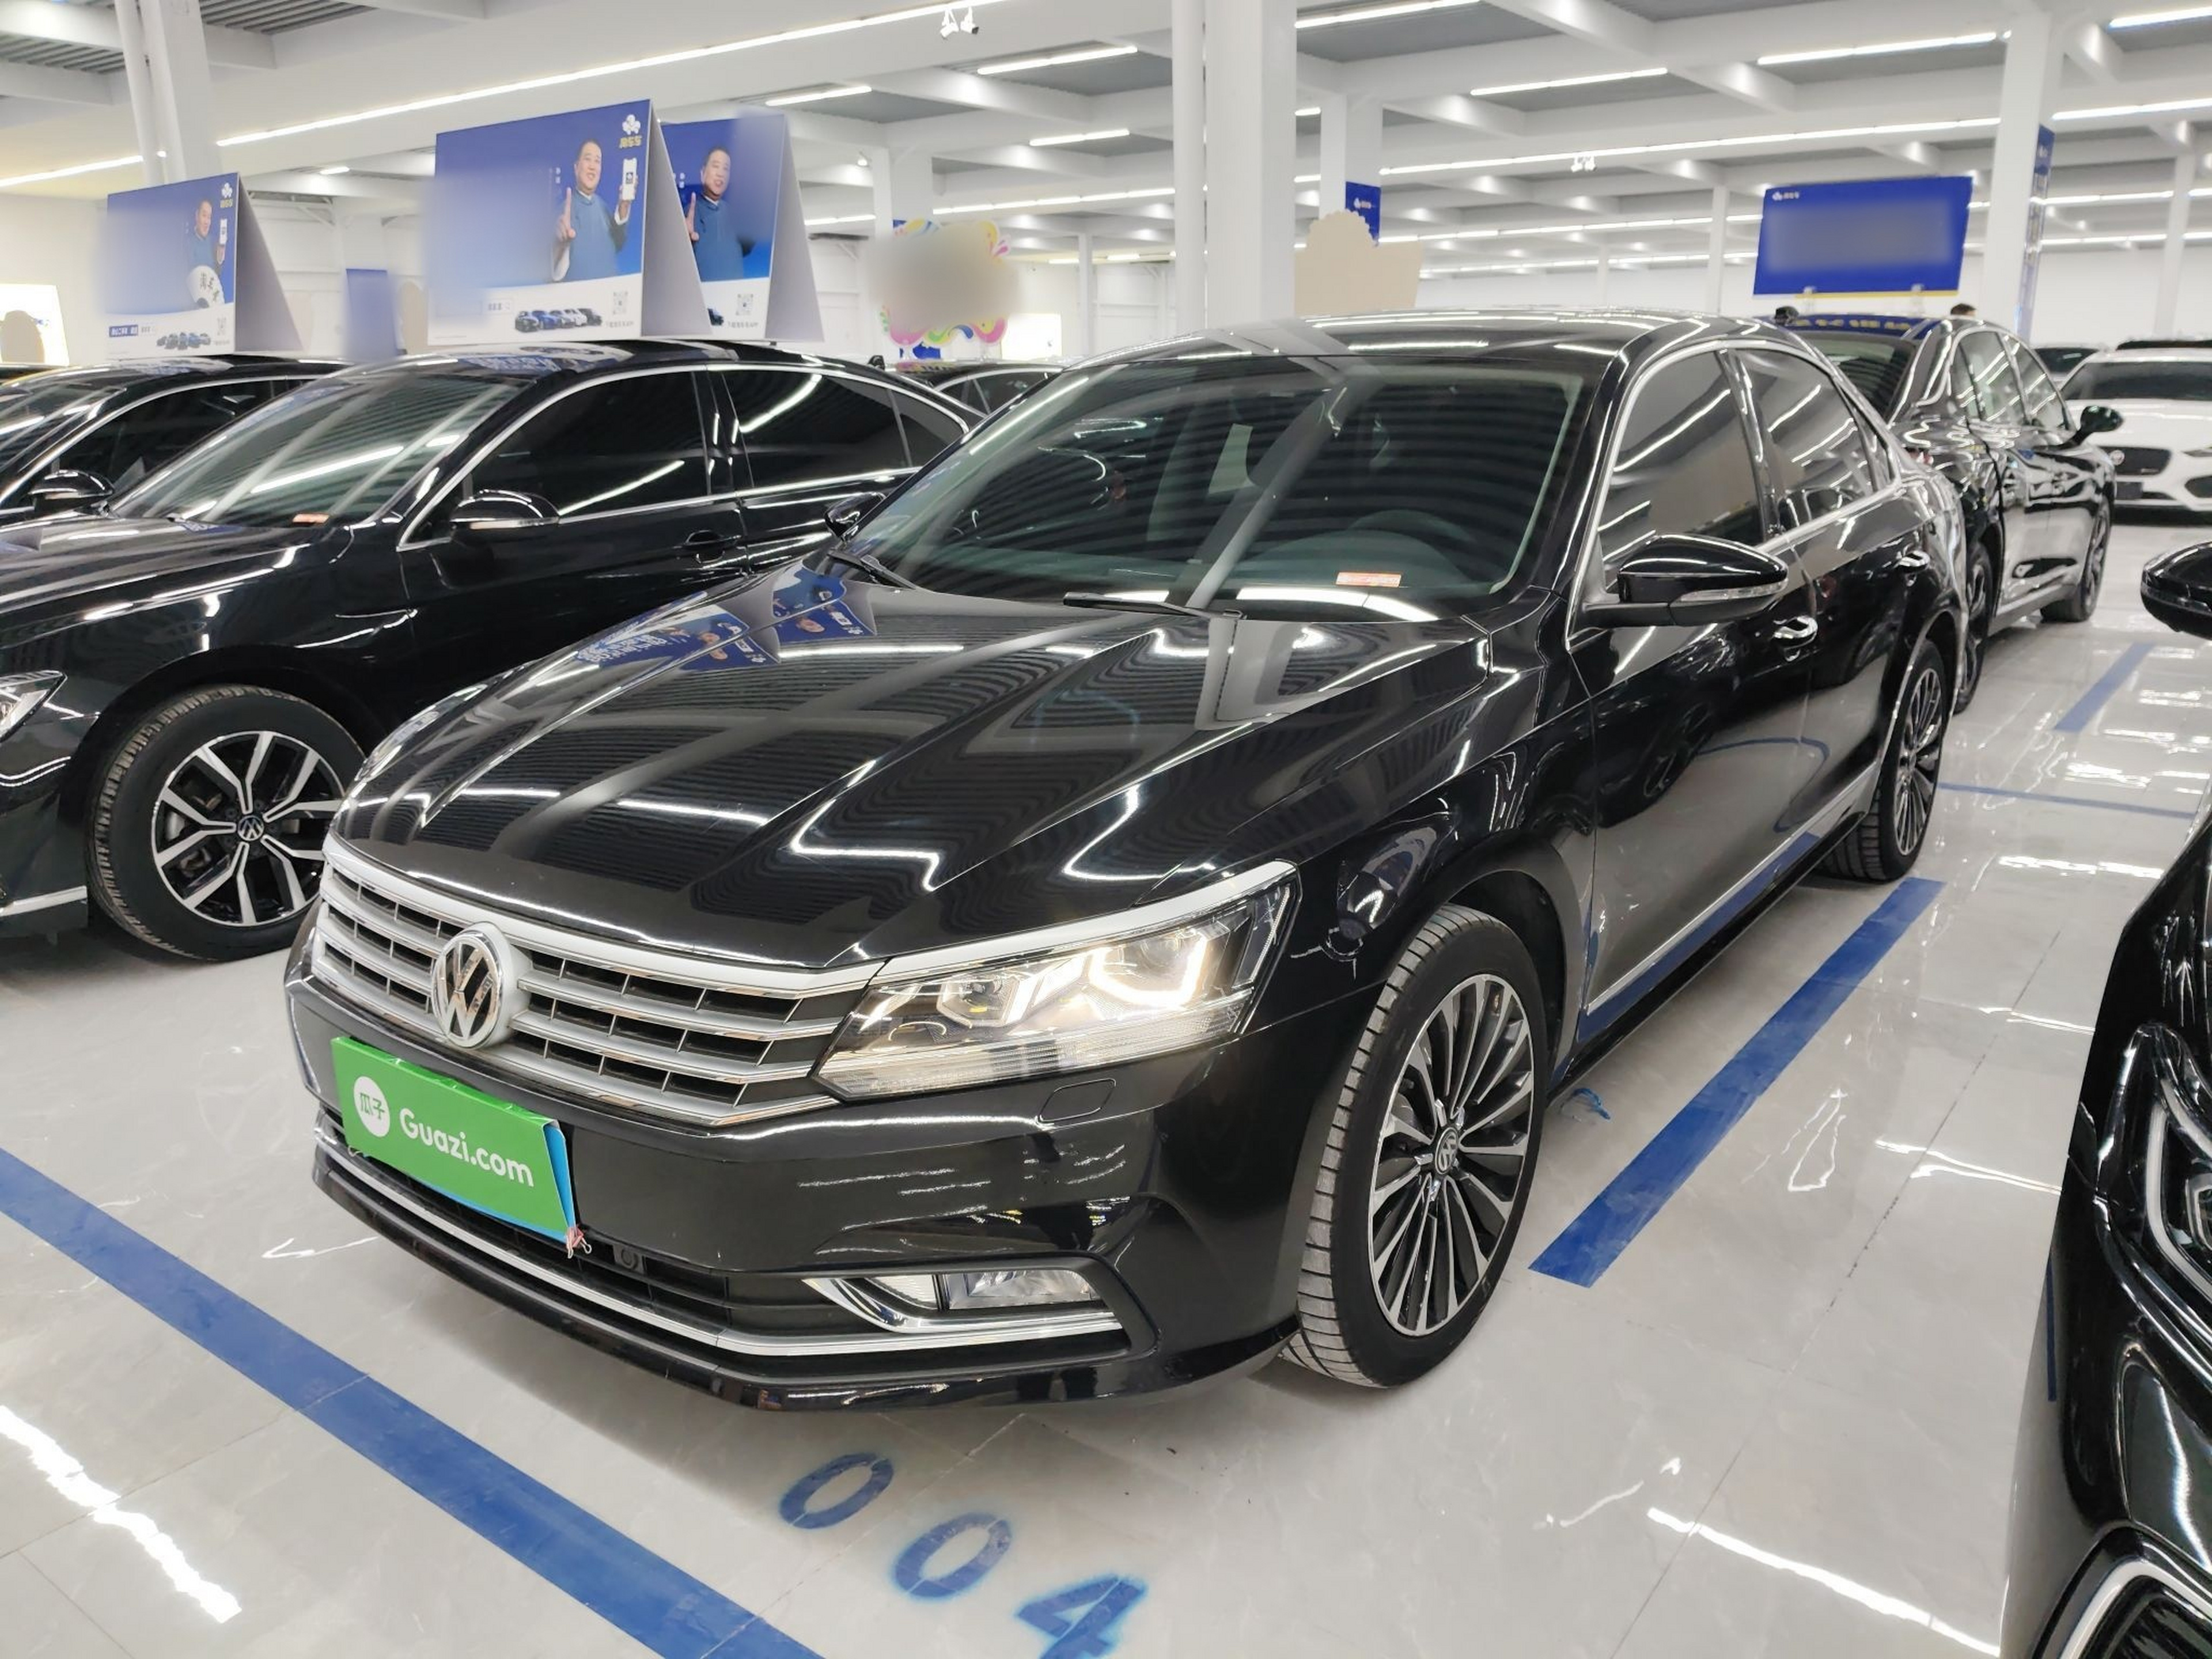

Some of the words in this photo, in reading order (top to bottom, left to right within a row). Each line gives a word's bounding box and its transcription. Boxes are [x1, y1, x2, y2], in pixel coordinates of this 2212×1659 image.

[433, 935, 500, 1048] VW
[359, 1092, 387, 1120] 瓜子
[399, 1108, 534, 1187] Guazi.com
